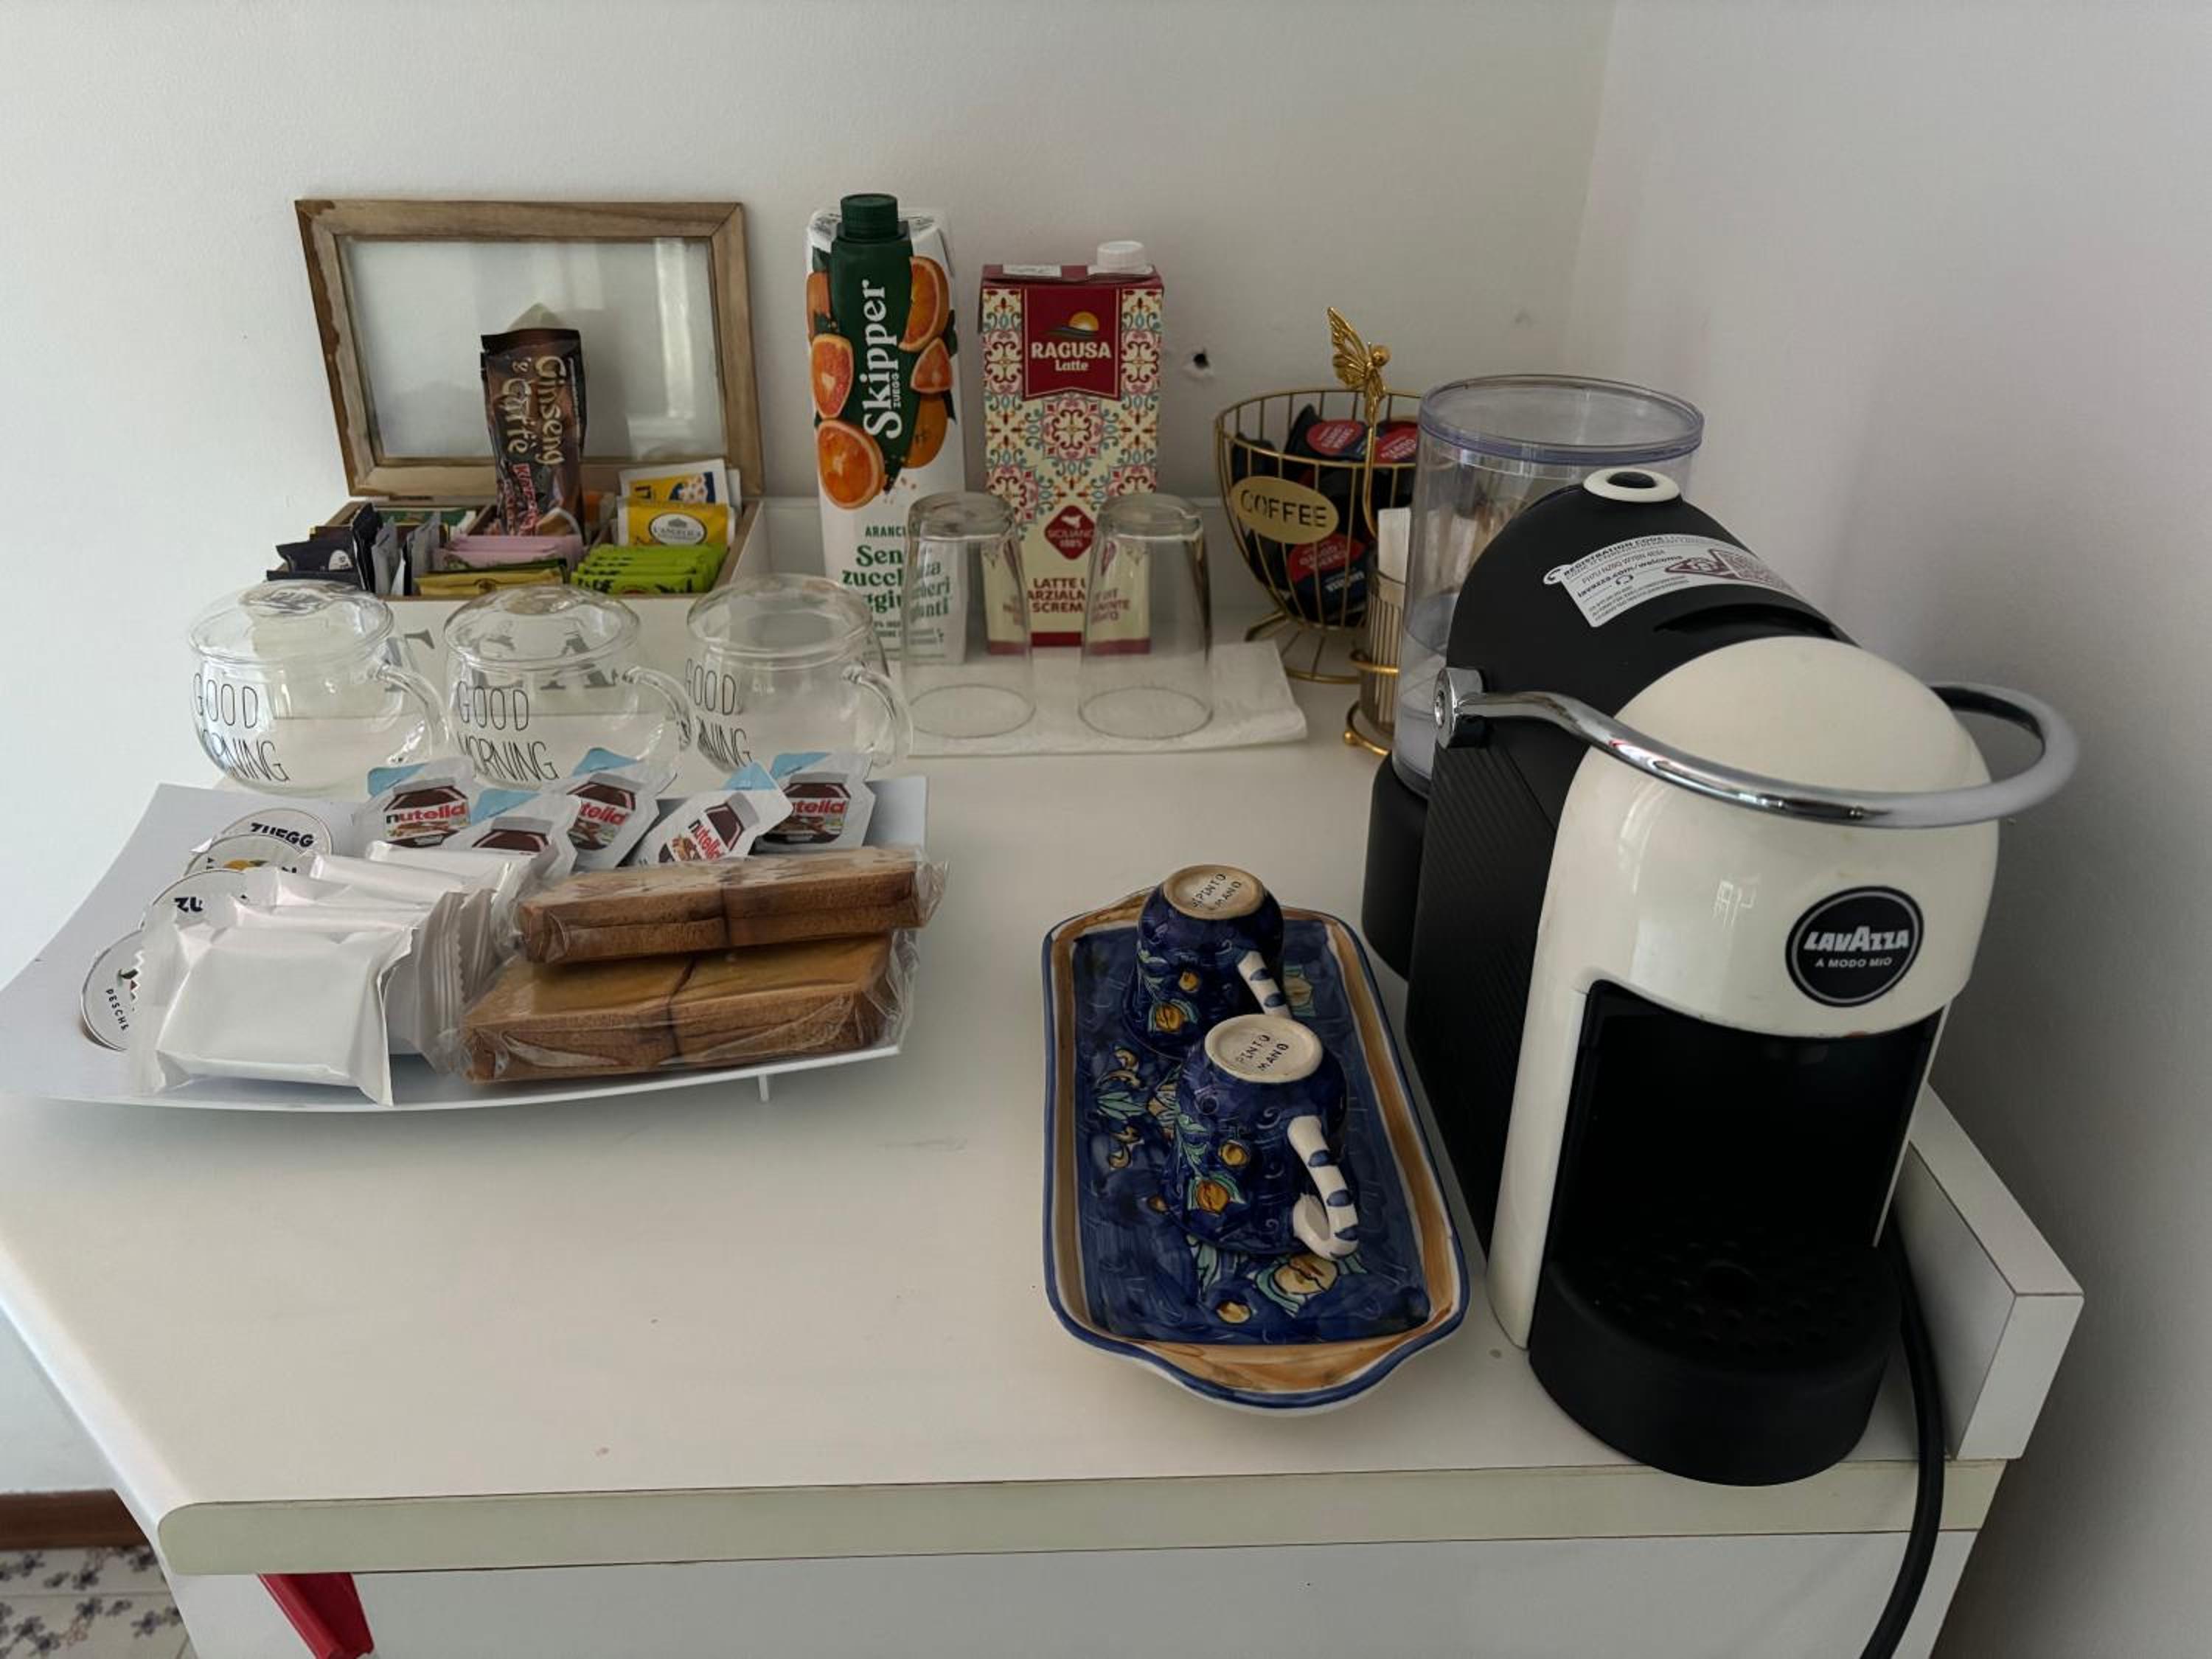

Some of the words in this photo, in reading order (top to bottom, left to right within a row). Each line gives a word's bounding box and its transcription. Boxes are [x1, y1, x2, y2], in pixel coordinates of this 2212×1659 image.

[859, 279, 902, 439] Skipper
[1032, 341, 1111, 358] RAGUSA
[1055, 359, 1088, 371] Latte
[535, 355, 566, 465] Ginseng
[1240, 490, 1326, 528] COFFEE
[865, 526, 905, 538] ARANCI
[1033, 578, 1077, 589] LATTE
[193, 672, 258, 728] GOOD
[456, 681, 529, 731] GOOD
[385, 802, 467, 824] nutella
[1804, 925, 1910, 952] LAVAZZA
[1815, 958, 1825, 968] A
[1828, 959, 1867, 968] MODO
[1868, 956, 1893, 967] MIO
[1257, 1043, 1290, 1072] MANO
